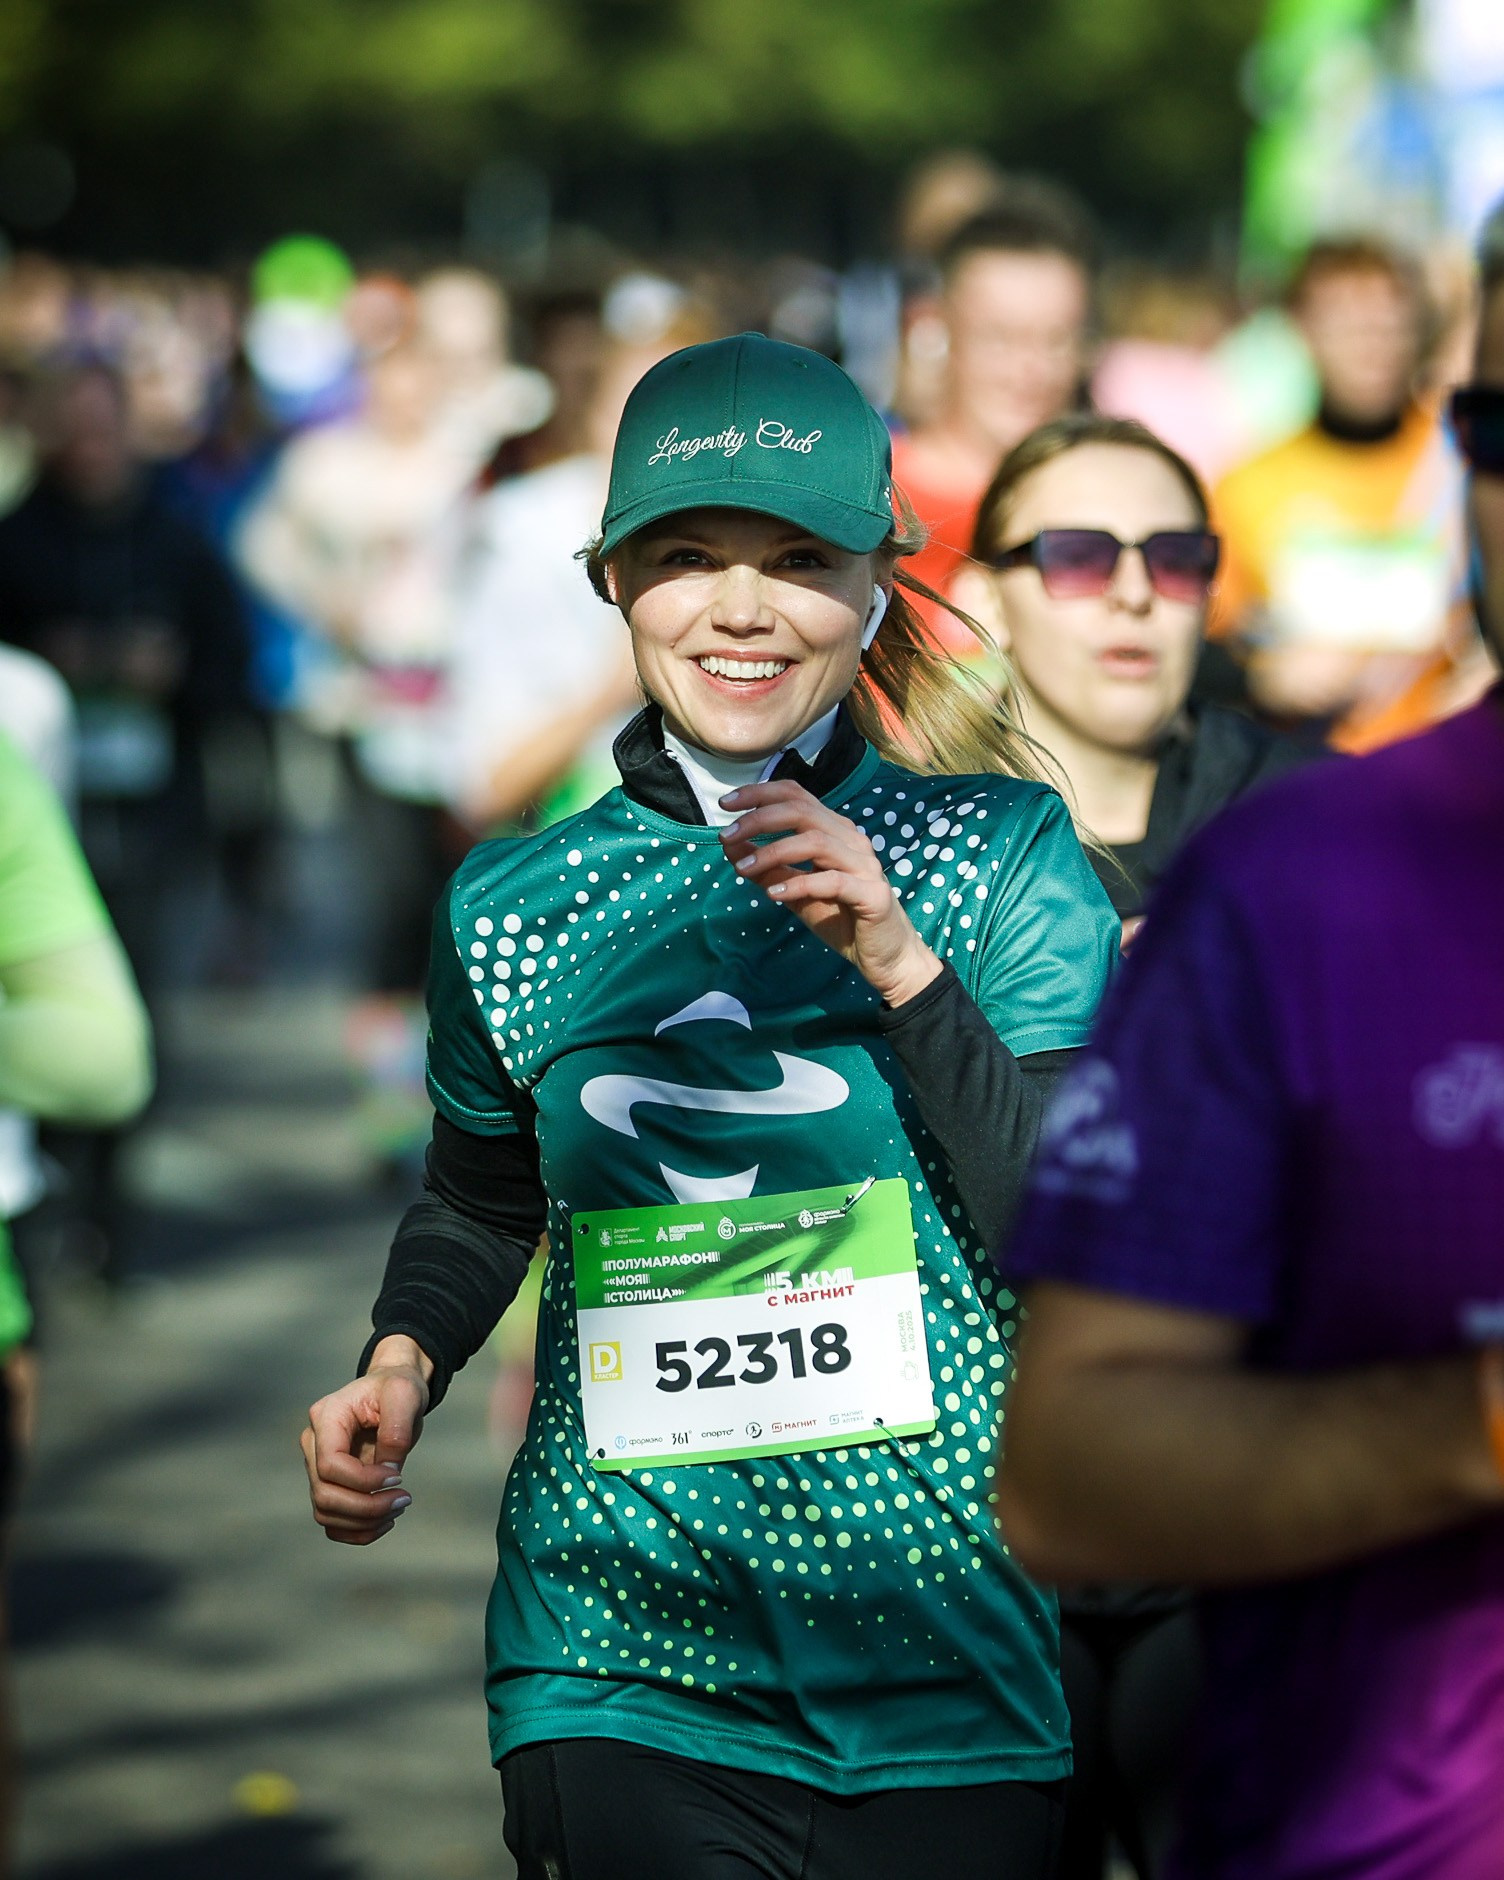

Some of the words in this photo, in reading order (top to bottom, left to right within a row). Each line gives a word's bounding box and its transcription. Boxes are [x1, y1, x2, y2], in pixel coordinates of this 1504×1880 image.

[648, 426, 747, 465] Longevity
[756, 418, 822, 453] Club
[754, 1222, 786, 1232] СТОЛИЦА
[606, 1252, 715, 1271] ПОЛУМАРАФОН
[774, 1270, 794, 1291] 5
[897, 1311, 907, 1352] МОСКВА
[592, 1344, 618, 1374] D
[655, 1323, 852, 1393] 52318
[784, 1419, 818, 1430] МАГНИТ
